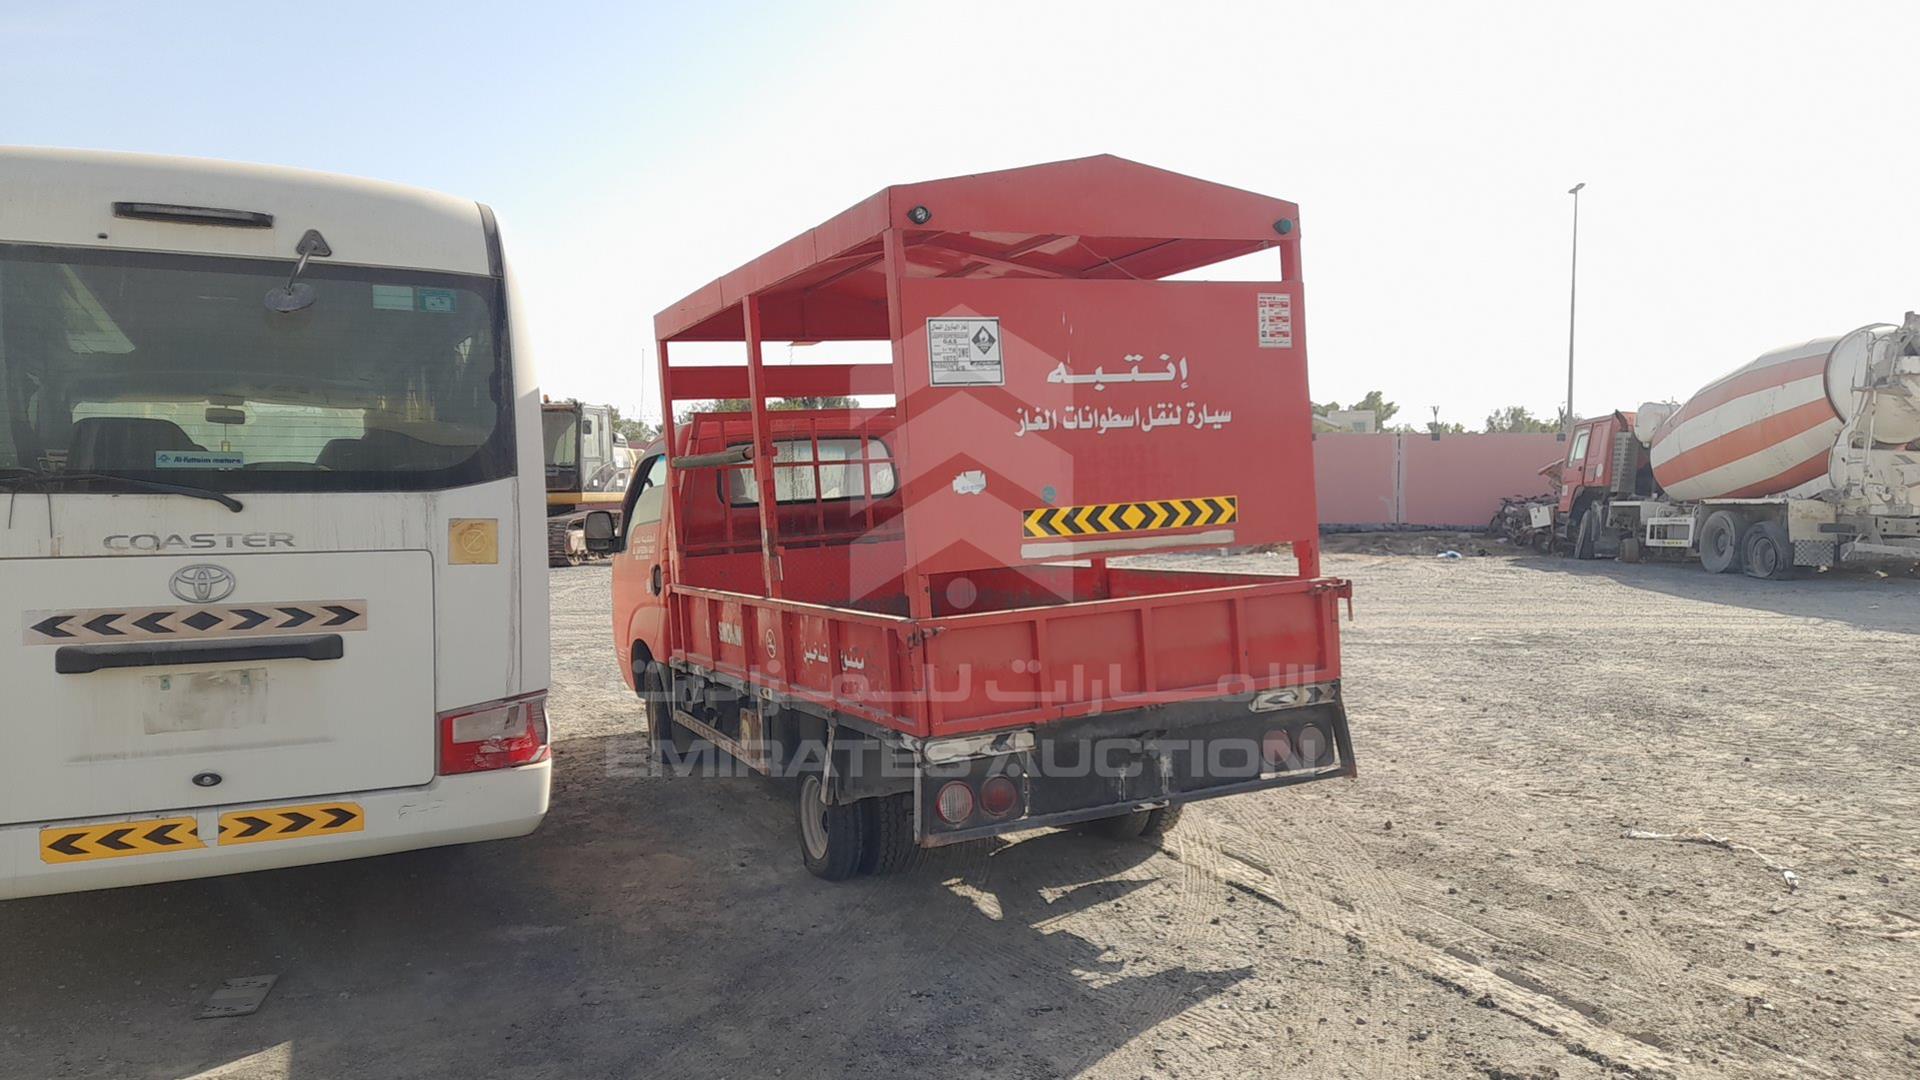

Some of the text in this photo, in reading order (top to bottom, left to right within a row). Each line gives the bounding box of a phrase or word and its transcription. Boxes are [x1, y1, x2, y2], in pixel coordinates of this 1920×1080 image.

[1015, 401, 1232, 437] سيارة لنقل اسطوانات الغاز
[102, 532, 297, 551] COASTER
